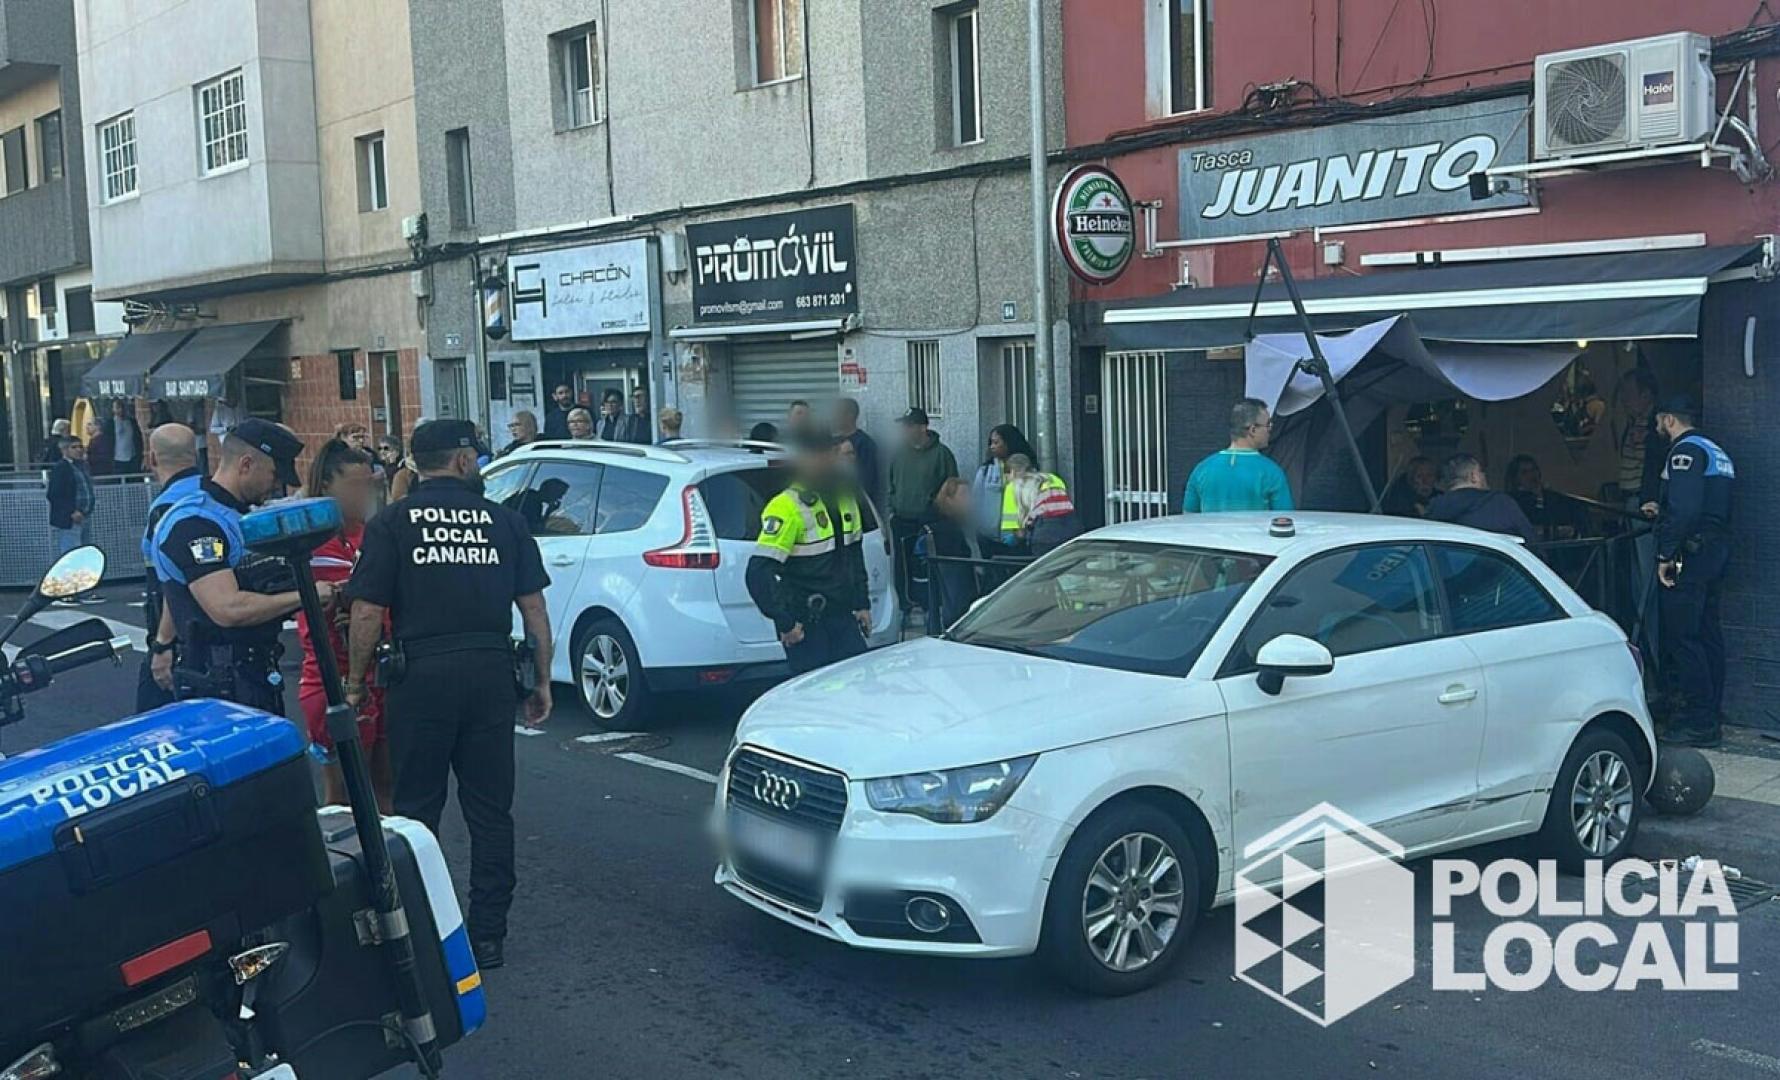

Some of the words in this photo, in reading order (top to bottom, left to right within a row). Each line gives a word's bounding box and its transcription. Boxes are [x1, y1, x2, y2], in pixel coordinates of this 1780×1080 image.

[1644, 82, 1673, 95] Haier
[1192, 150, 1252, 172] Tasca
[1201, 135, 1498, 218] JUANITO
[559, 263, 631, 286] CHACÓN
[812, 294, 828, 307] 871
[830, 293, 846, 306] 201
[165, 380, 178, 396] BAR
[179, 379, 209, 396] SANTIAGO
[409, 507, 493, 525] POLICIA
[422, 527, 489, 544] LOCAL
[412, 546, 500, 565] CANARIA
[58, 760, 188, 818] LOCAL
